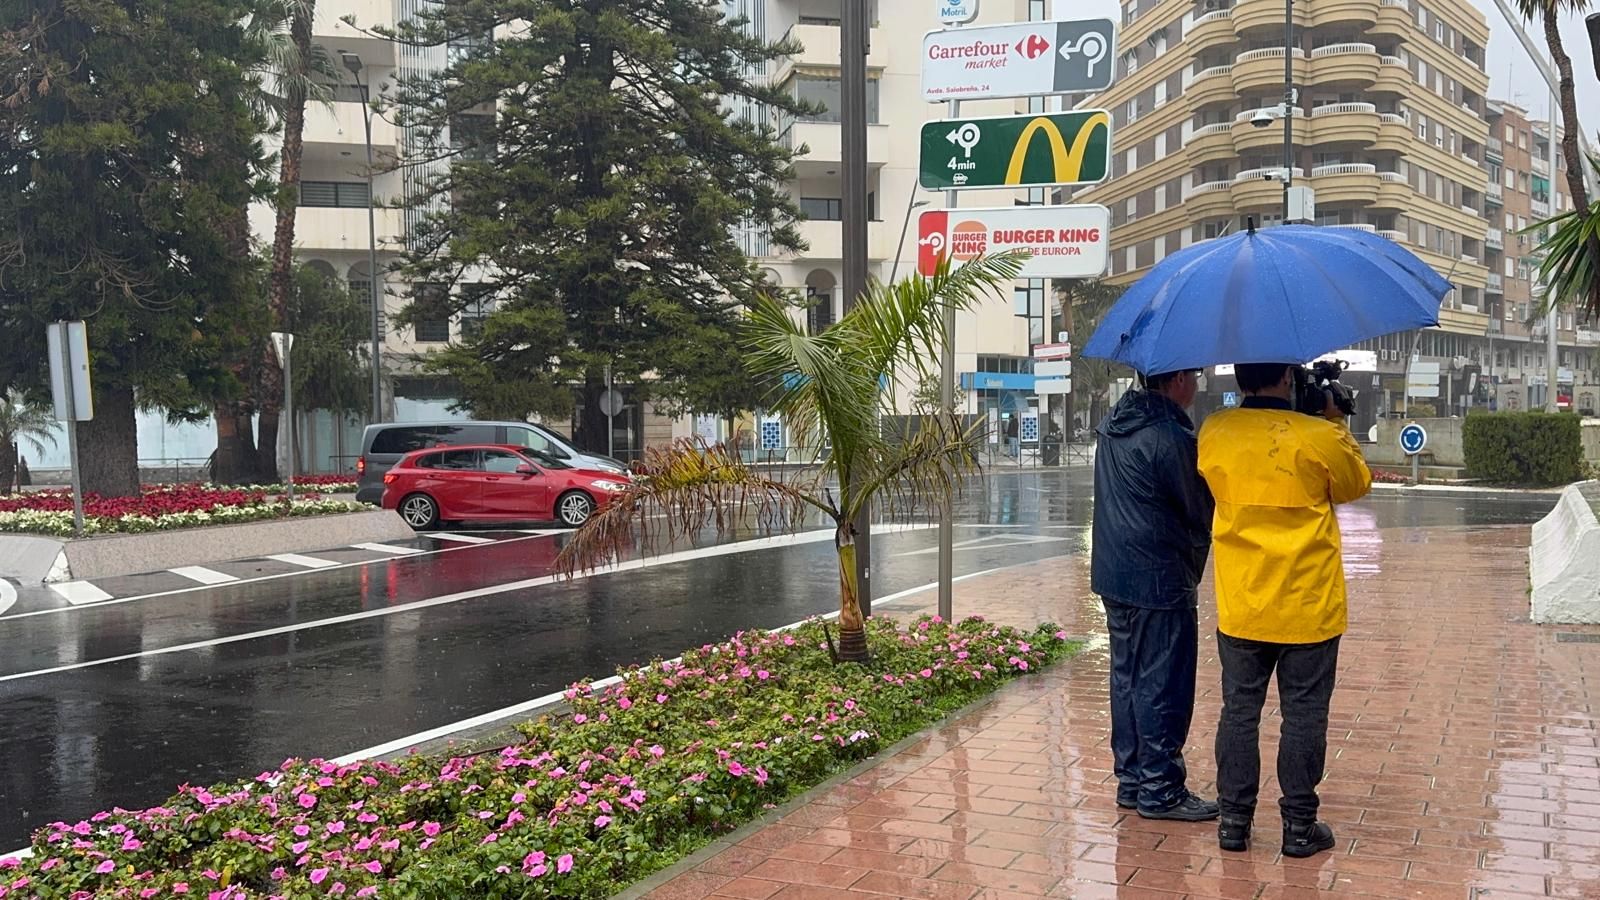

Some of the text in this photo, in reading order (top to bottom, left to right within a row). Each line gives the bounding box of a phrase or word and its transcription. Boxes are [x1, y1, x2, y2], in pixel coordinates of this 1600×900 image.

[941, 7, 968, 17] Motril
[928, 41, 1009, 60] Carrefour
[965, 57, 1008, 70] market
[947, 157, 976, 170] 4min
[952, 233, 987, 242] BURGER
[993, 229, 1100, 244] BURGER KING
[952, 242, 987, 254] KING
[1042, 247, 1081, 256] EUROPA
